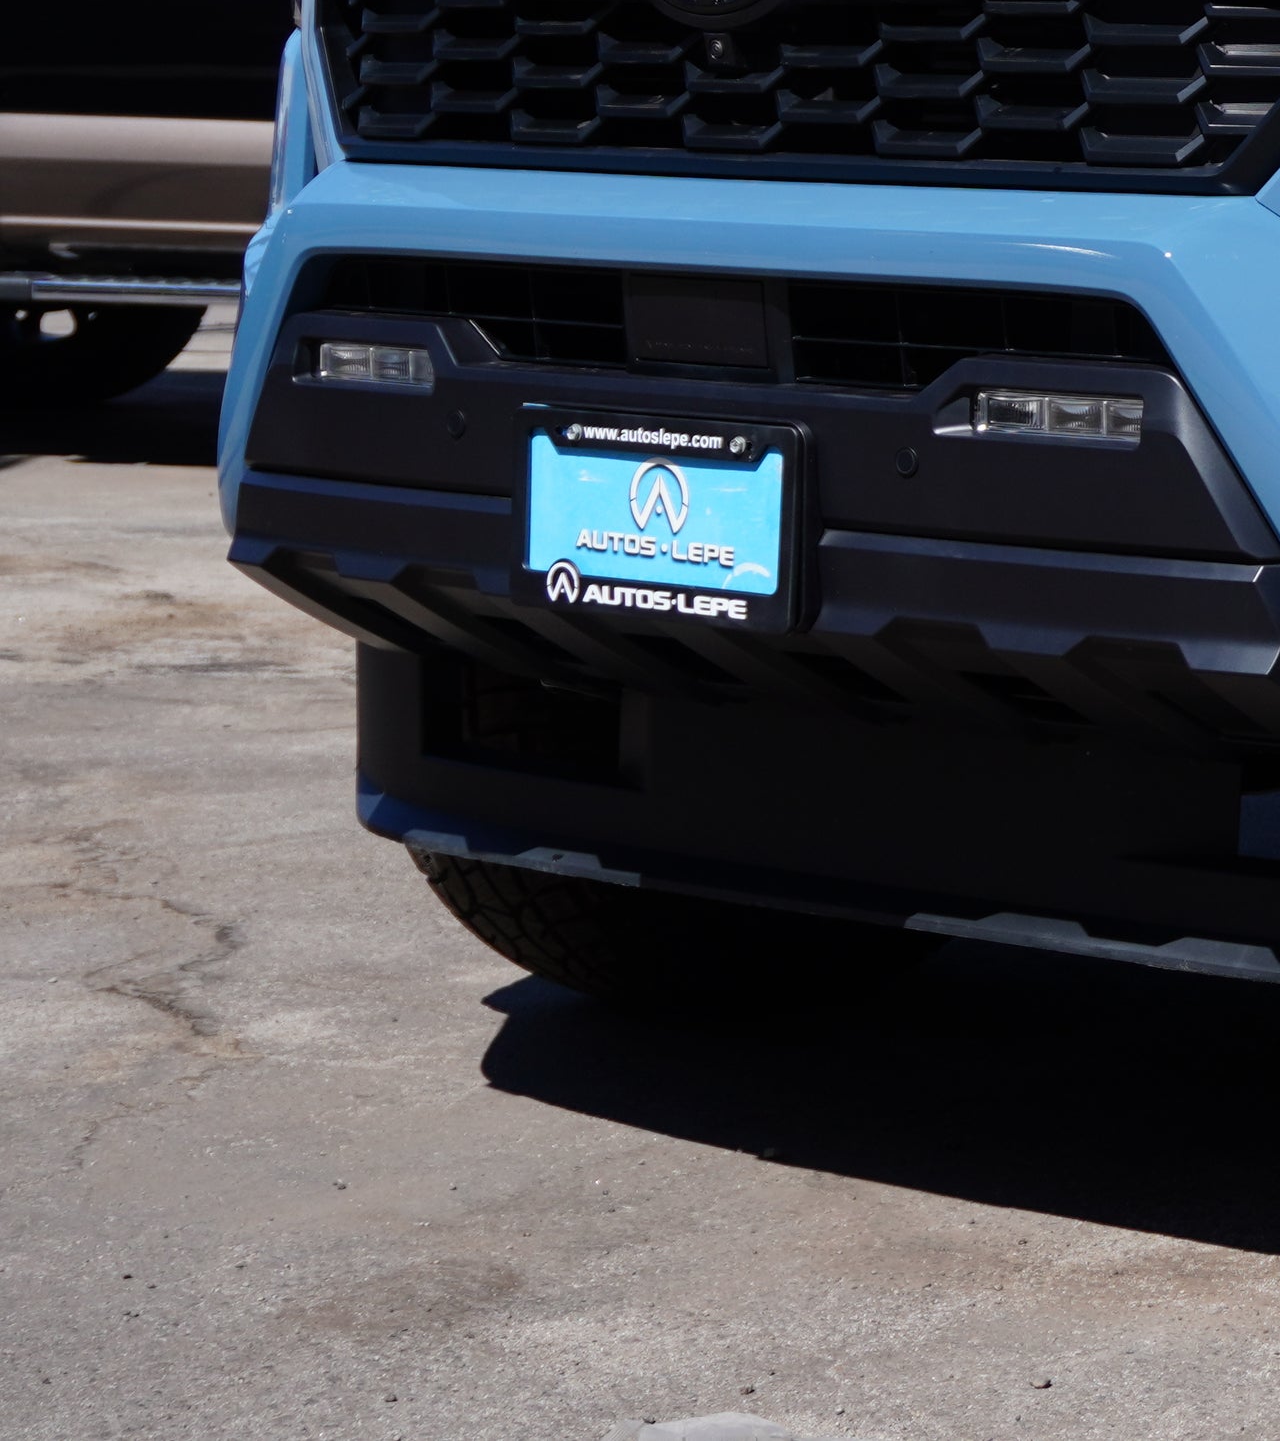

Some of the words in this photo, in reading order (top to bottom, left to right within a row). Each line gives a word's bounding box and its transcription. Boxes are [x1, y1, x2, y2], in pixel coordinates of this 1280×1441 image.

[583, 425, 723, 449] www.autoslepe.com
[576, 529, 656, 557] AUTOS
[671, 541, 735, 567] LEPE
